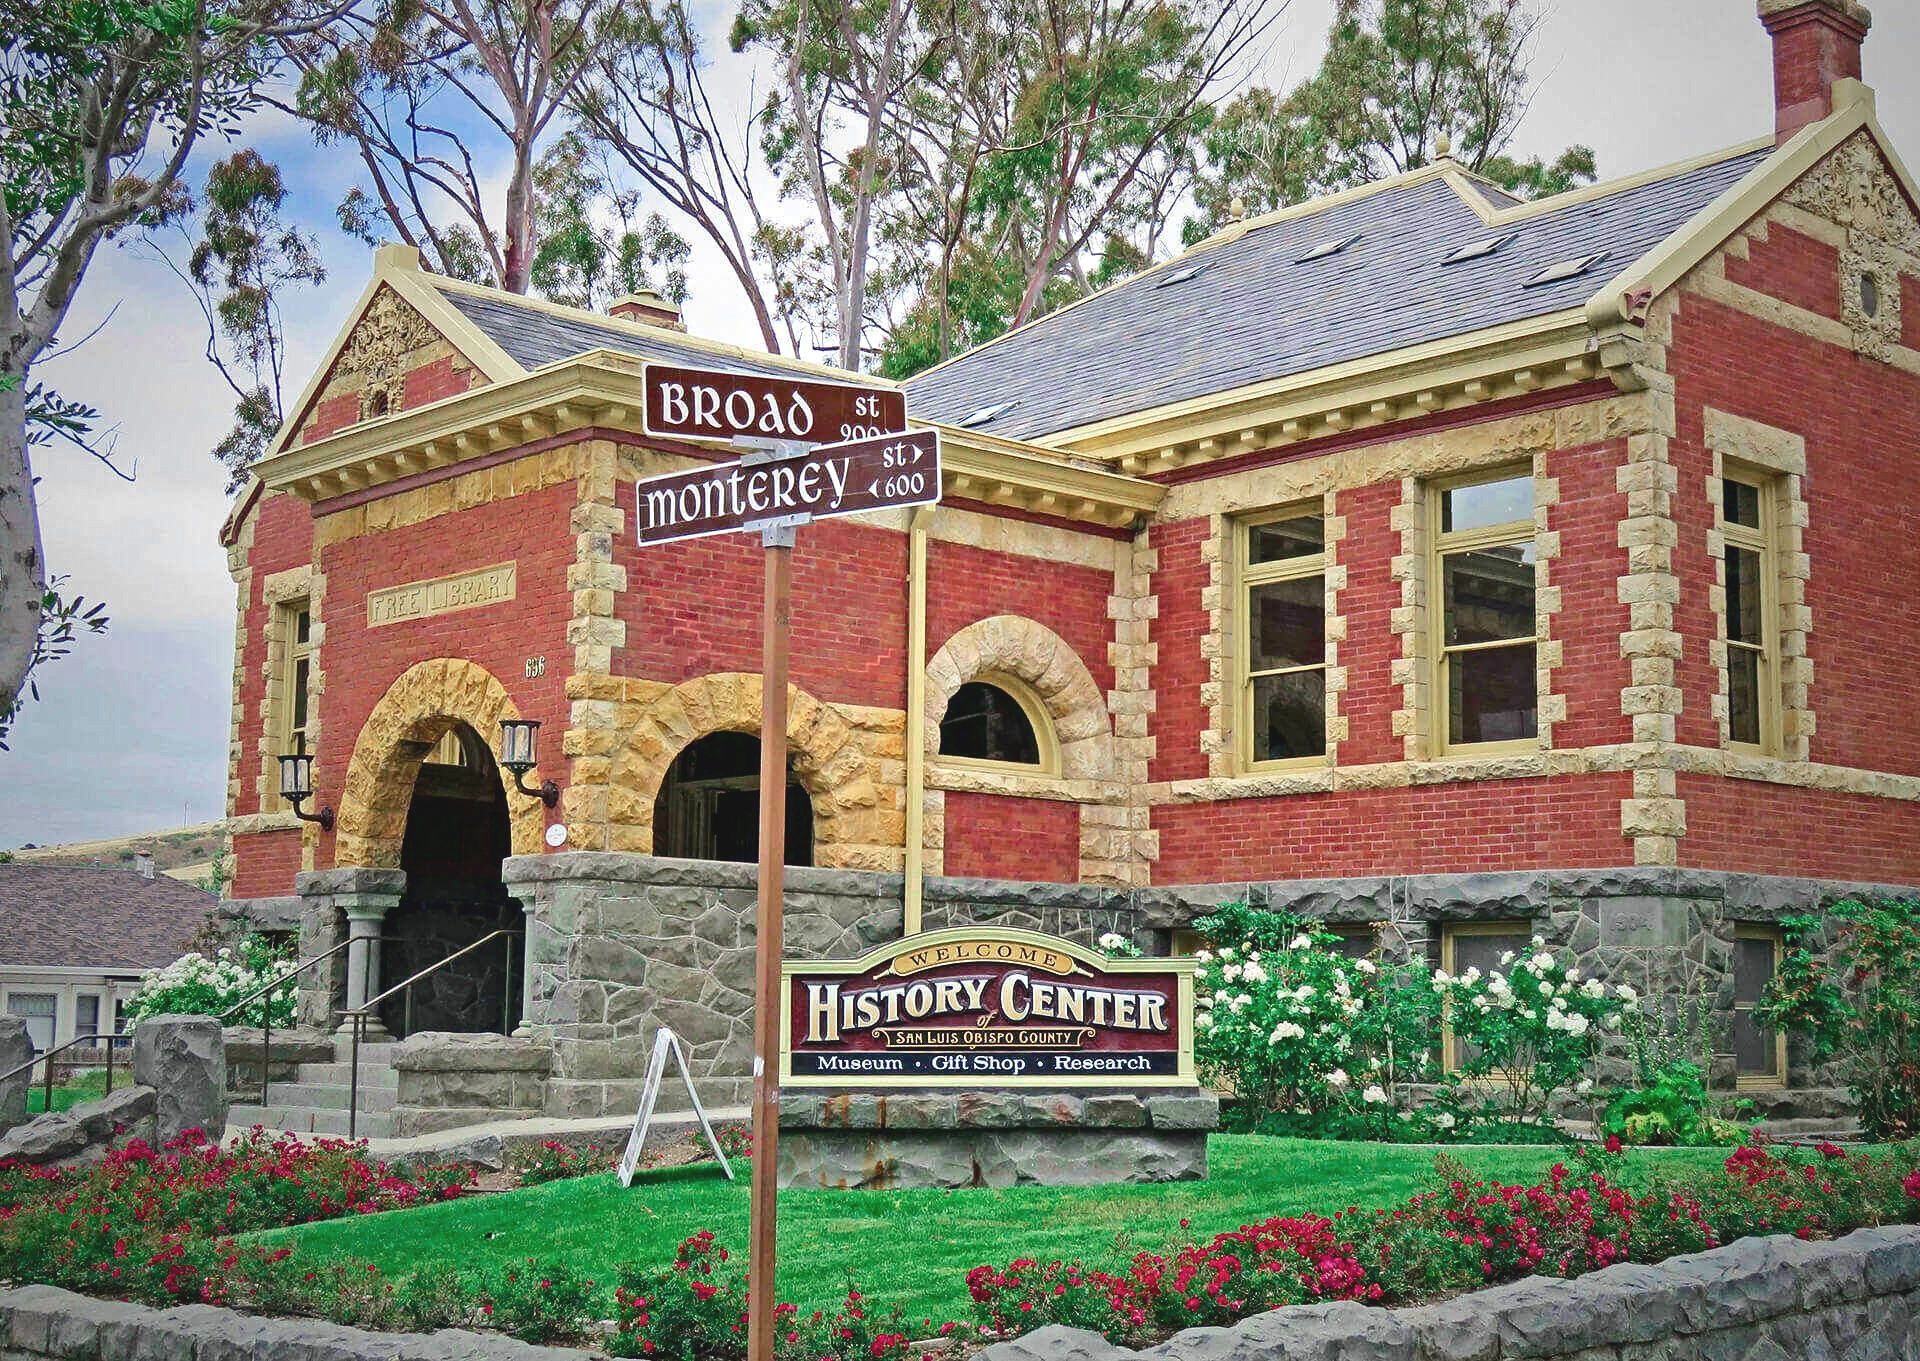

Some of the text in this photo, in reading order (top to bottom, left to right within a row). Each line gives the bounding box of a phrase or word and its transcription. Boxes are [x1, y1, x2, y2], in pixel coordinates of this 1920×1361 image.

[884, 472, 925, 498] 600
[371, 567, 515, 623] FREE LIBRARY
[909, 943, 1058, 968] WELCOME
[804, 972, 1169, 1044] HISTORY CENTER
[976, 1011, 998, 1028] of
[896, 1031, 1071, 1044] SAN LUIS OBISPO COUNTY
[817, 1055, 1151, 1075] Museum Gift Shop Research
